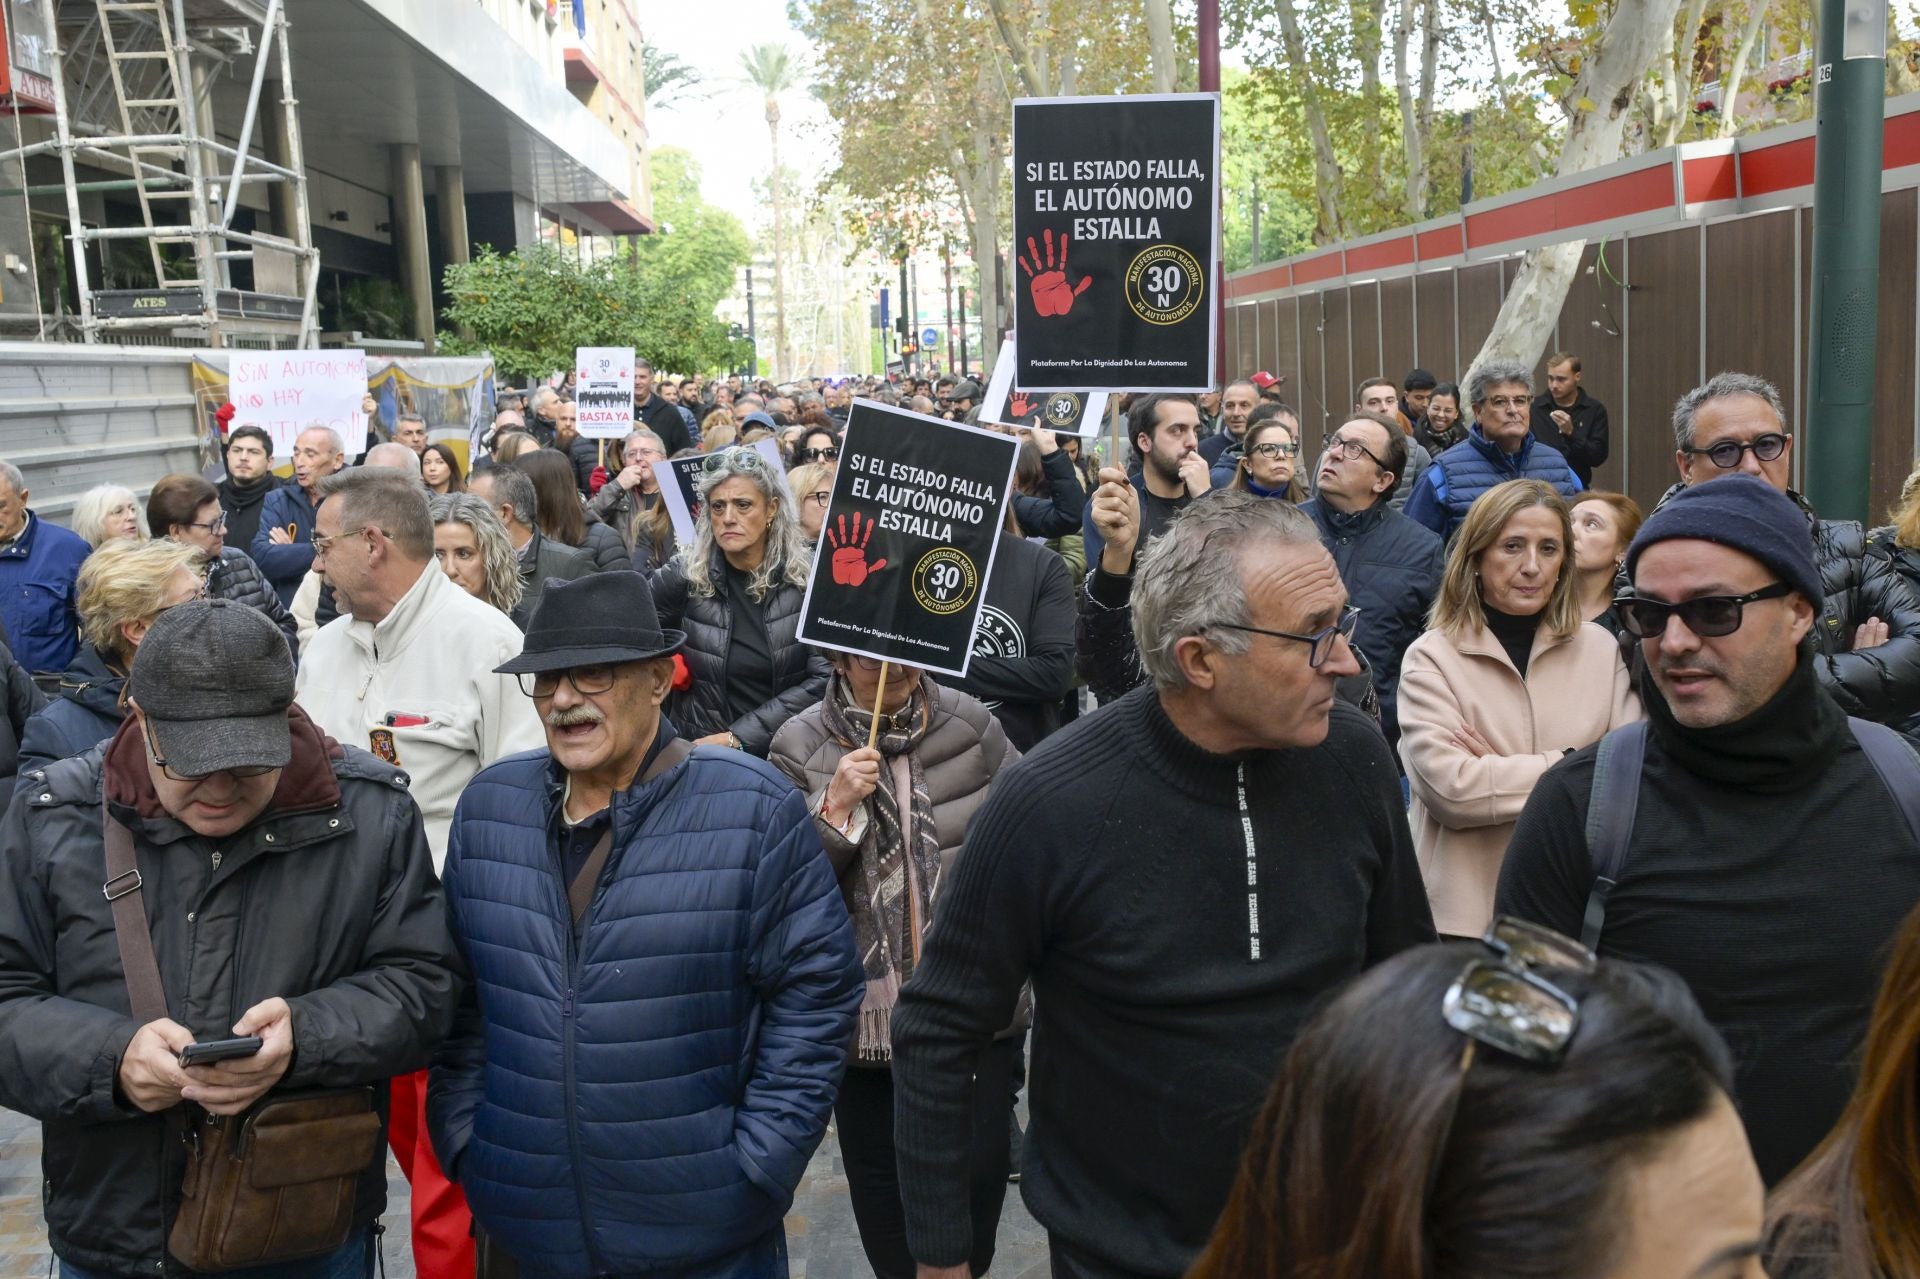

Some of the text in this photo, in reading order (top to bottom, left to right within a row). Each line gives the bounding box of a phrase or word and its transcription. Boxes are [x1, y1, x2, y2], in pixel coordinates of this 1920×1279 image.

[1027, 159, 1205, 181] SI EL ESTADO FALLA,
[1035, 183, 1193, 212] EL AUTÓNOMO
[1074, 217, 1162, 240] ESTALLA
[1130, 249, 1199, 287] MANIFESTACIÓN NACIONAL
[1147, 265, 1180, 293] 30
[132, 297, 167, 308] ATES
[1135, 301, 1193, 321] DE AUTÓNOMOS
[1157, 293, 1170, 308] N
[599, 359, 610, 368] 30
[1030, 359, 1069, 367] Plataforma
[1084, 359, 1093, 367] La
[1094, 359, 1123, 368] Dignidad
[1124, 359, 1134, 367] De
[1134, 359, 1146, 367] Los
[1147, 359, 1187, 367] Autonomos
[579, 412, 630, 422] BASTA YA
[1055, 399, 1071, 413] 30
[1058, 411, 1065, 419] N
[681, 463, 690, 473] SI
[691, 462, 701, 471] EL
[850, 454, 996, 505] SI EL ESTADO FALLA,
[851, 477, 984, 525] EL AUTÓNOMO
[878, 508, 953, 543] ESTALLA
[918, 551, 974, 588] MANIFESTACIÓN NACIONAL
[930, 563, 960, 589] 30
[917, 590, 926, 600] DE
[935, 587, 947, 600] N
[817, 616, 950, 652] Plataforma Por La Dignidad De Los Autonomos
[1241, 817, 1256, 857] EXCHANGE
[1247, 860, 1257, 886] JEANS
[1248, 893, 1259, 934] EXCHANGE
